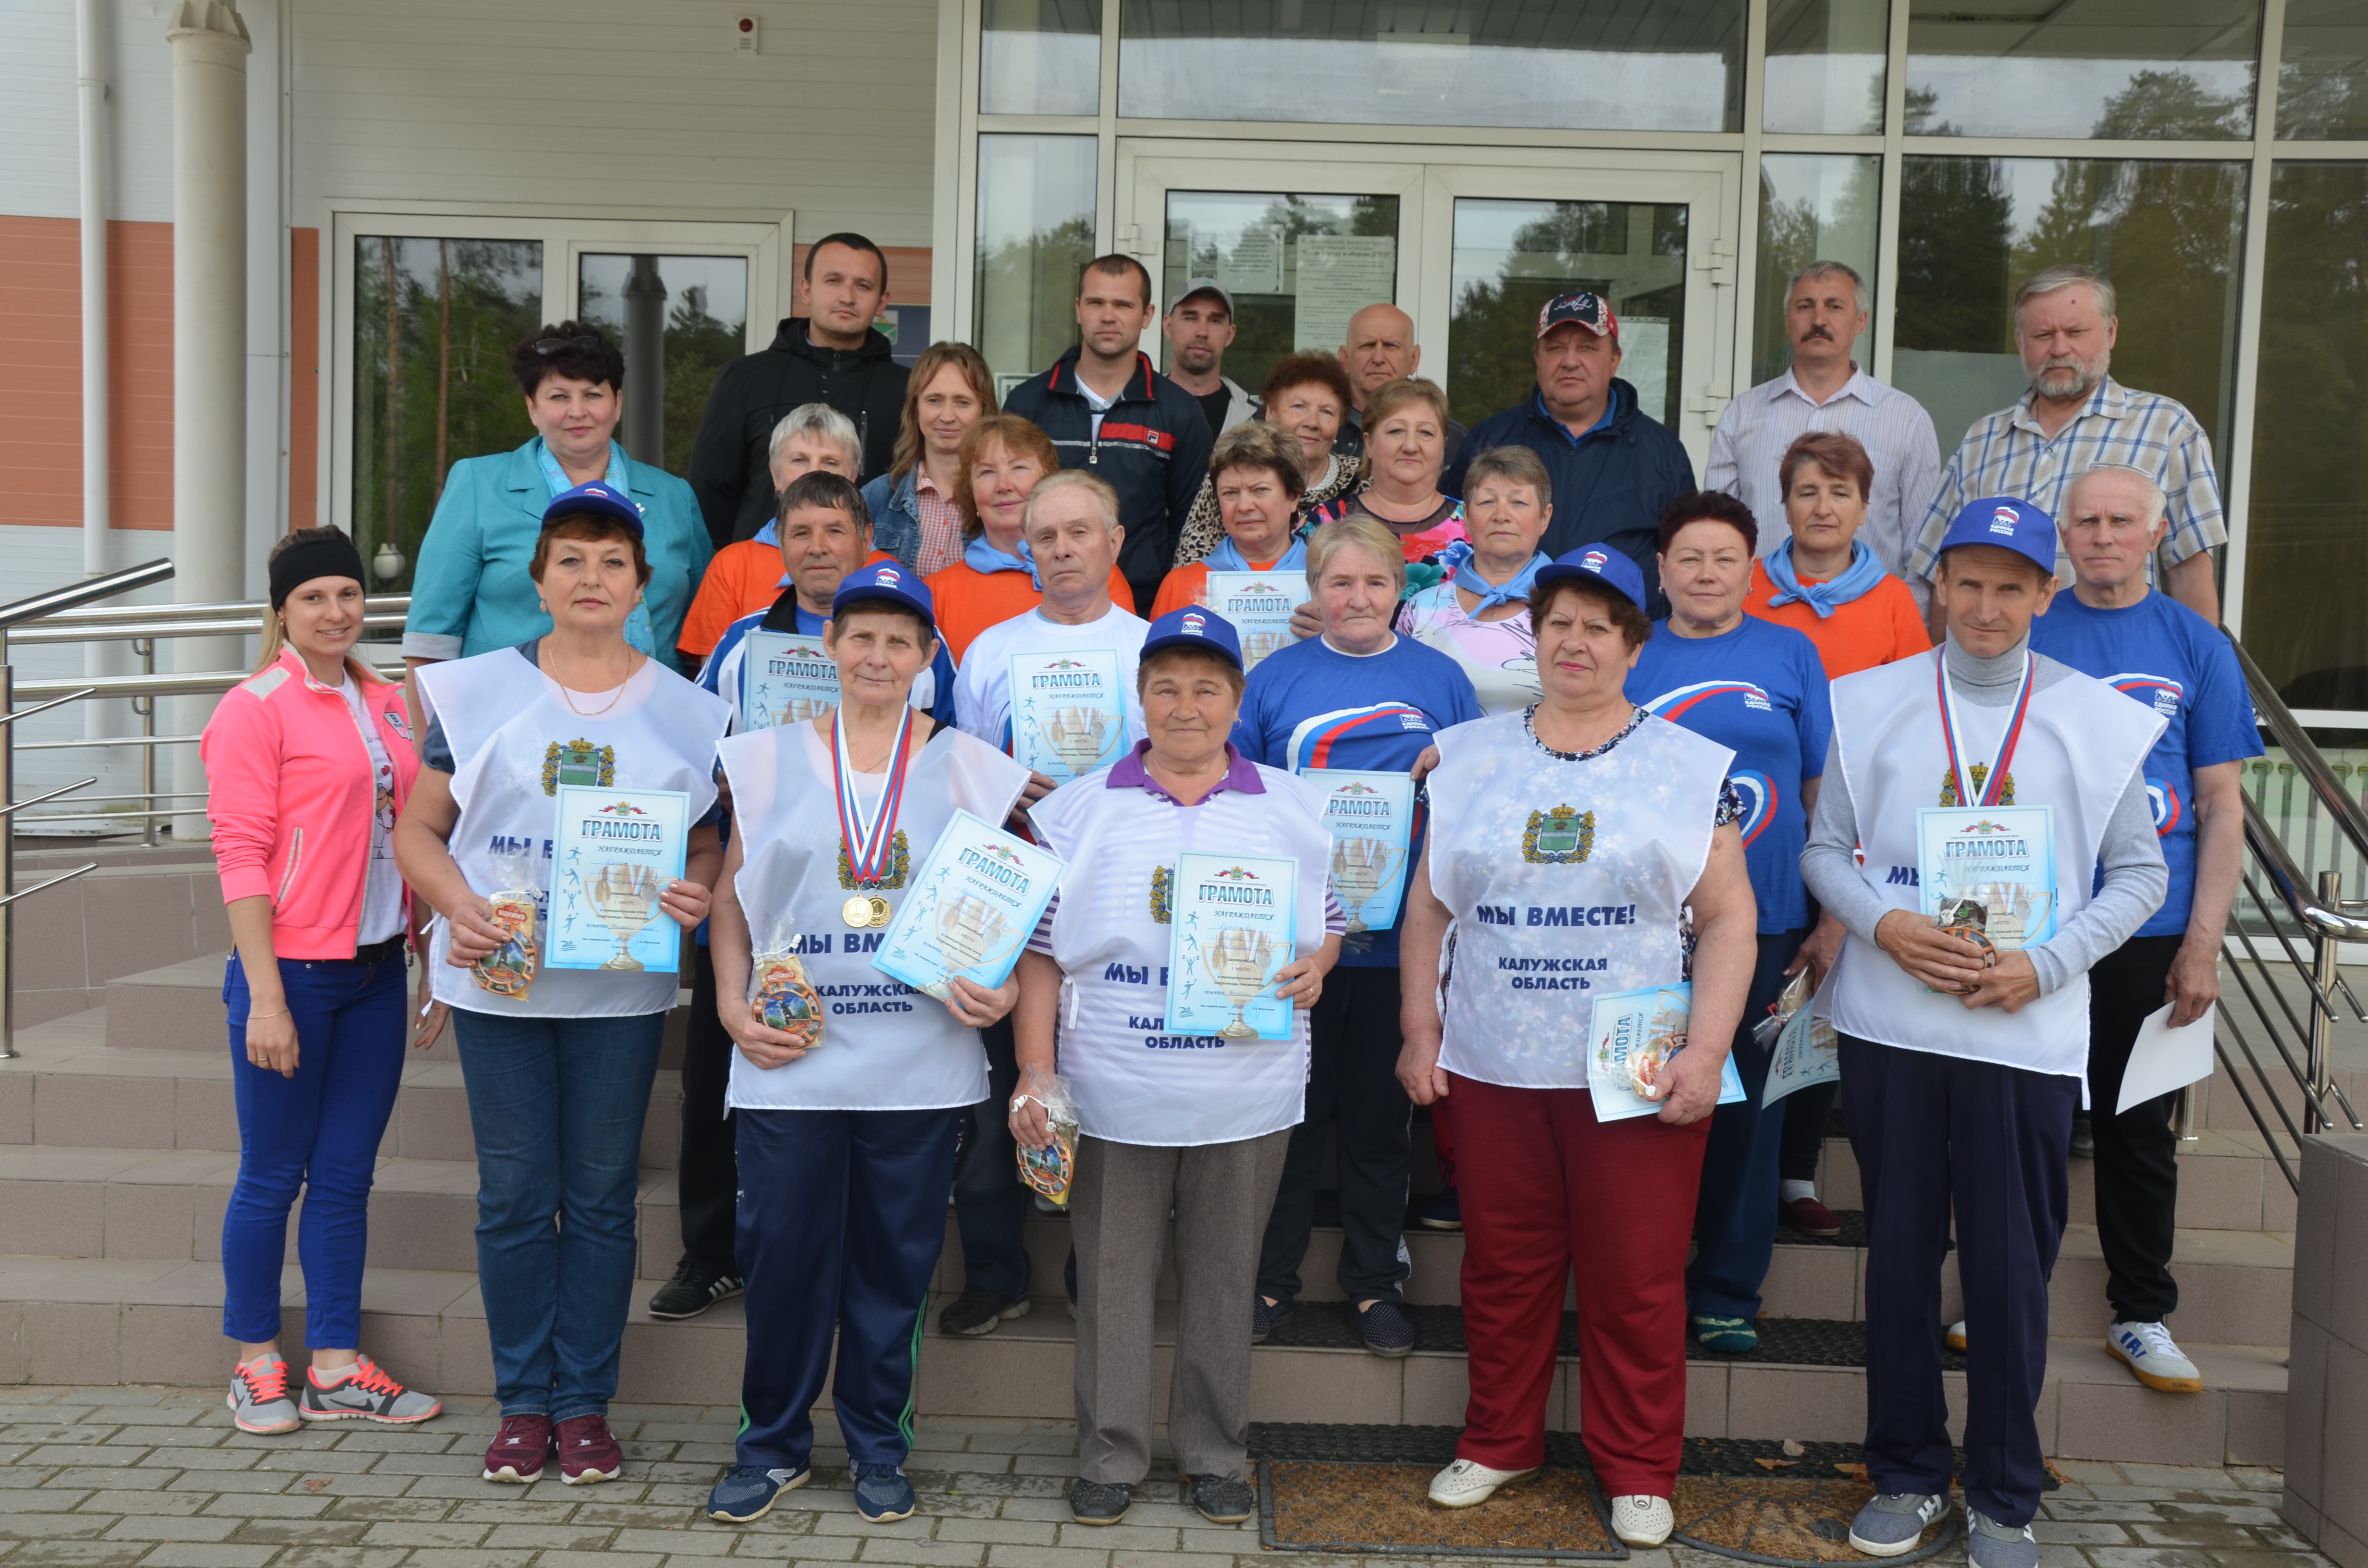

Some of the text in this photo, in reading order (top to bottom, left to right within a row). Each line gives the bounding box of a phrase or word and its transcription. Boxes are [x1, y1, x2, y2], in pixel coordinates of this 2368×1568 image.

[1989, 528, 2013, 536] РОССИЯ
[1990, 524, 2014, 532] ЕДИНАЯ
[1227, 598, 1292, 613] ГРАМОТА
[768, 660, 839, 681] ГРАМОТА
[783, 683, 840, 693] НАГРАЖДАЕТСЯ
[1032, 673, 1102, 689] ГРАМОТА
[1328, 799, 1391, 817] РАМОТА
[581, 820, 662, 841] ГРАМОТА
[1335, 822, 1392, 831] НАГРАЖДАЕТСЯ
[488, 835, 531, 858] МЫ
[598, 845, 663, 856] НАГРАЖДАЕТСЯ
[1946, 839, 2029, 859] ГРАМОТА
[957, 847, 1032, 896] ГРАМОТА
[965, 875, 1022, 908] НАГРАЖДАЕТСЯ
[1198, 883, 1274, 906] ГРАМОТА
[498, 909, 526, 920] ЯШКИНО
[1214, 910, 1274, 920] НАГРАЖДАЕТСЯ
[1477, 904, 1636, 927] МЫ ВМЕСТЕ!
[789, 934, 831, 954] МЫ
[961, 933, 975, 943] МЕСТО
[1499, 957, 1607, 971] КАЛУЖСКАЯ
[767, 972, 793, 980] ЯШКИНО
[1104, 962, 1148, 985] МЫ
[815, 984, 925, 997] КАЛУЖСКА
[1512, 977, 1591, 990] ОБЛАСТЬ
[832, 1001, 913, 1015] ОБЛАСТЬ
[1145, 1036, 1225, 1049] ОБЛАСТЬ
